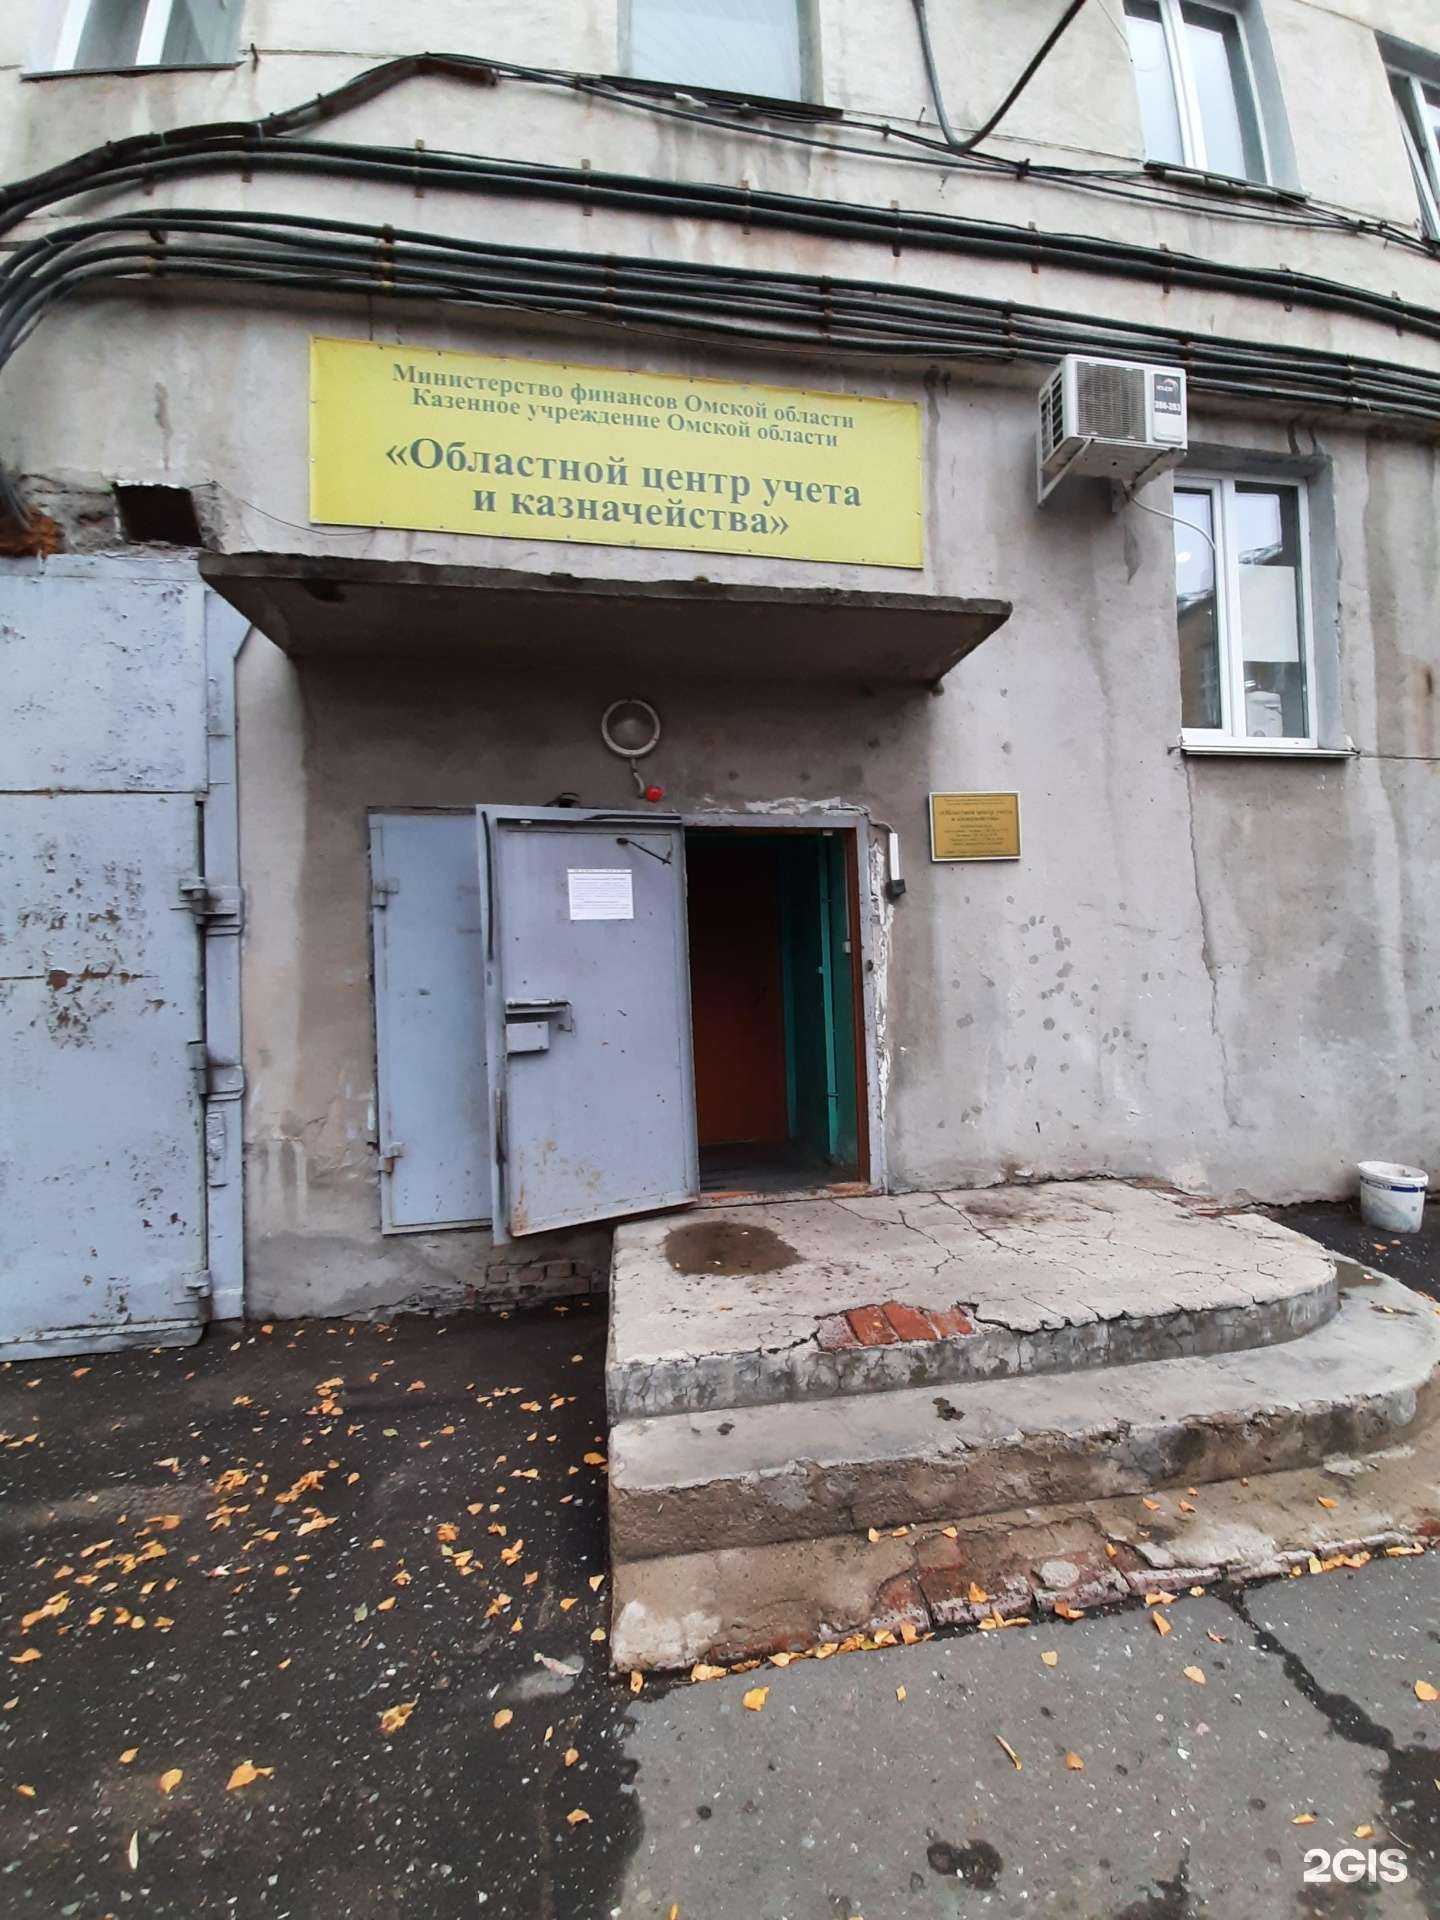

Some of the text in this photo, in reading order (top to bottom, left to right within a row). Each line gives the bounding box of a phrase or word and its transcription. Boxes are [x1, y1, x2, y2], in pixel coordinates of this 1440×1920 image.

[392, 363, 854, 429] Министерство финансов Омской области
[412, 387, 838, 447] Казенное учреждение Омской области
[386, 437, 862, 507] «Областной центр учета
[473, 489, 789, 535] и казначейства»
